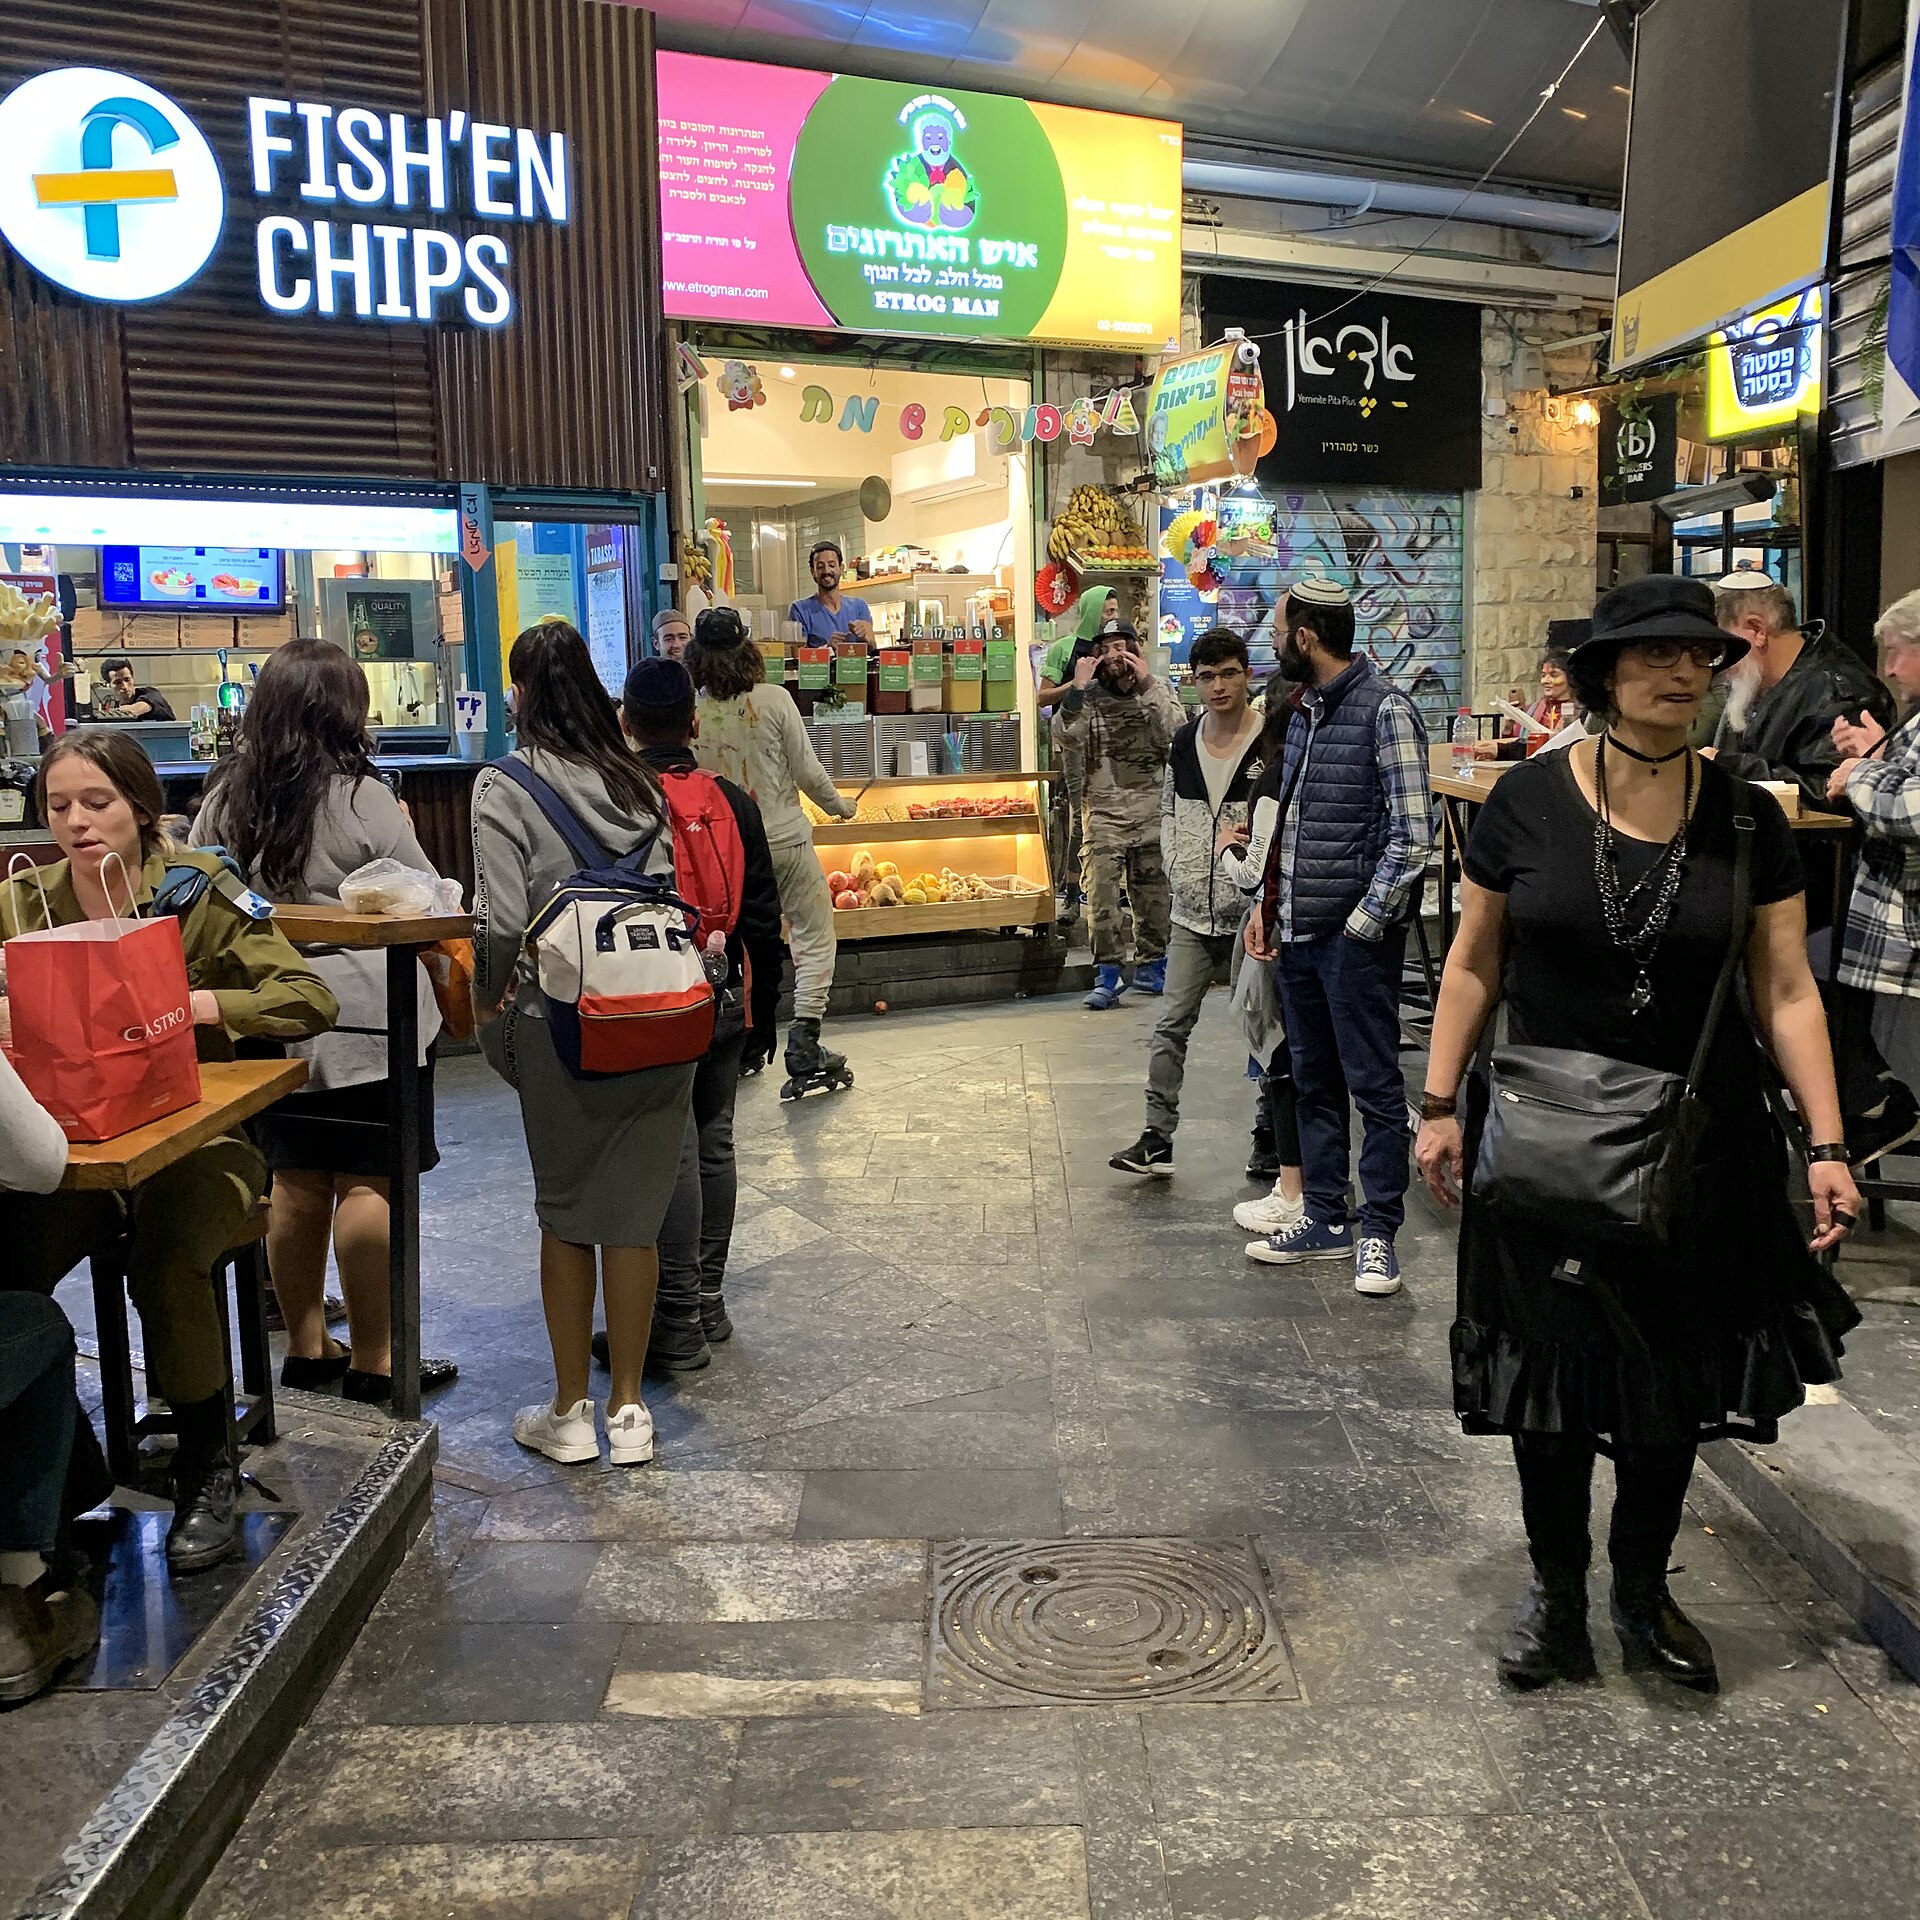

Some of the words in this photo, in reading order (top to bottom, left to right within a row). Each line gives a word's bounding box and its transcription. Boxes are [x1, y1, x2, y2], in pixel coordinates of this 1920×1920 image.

[680, 121, 715, 134] הטובים
[719, 126, 765, 139] הפתרונות
[666, 135, 697, 149] ללידה
[249, 97, 568, 222] FISH'EN
[676, 155, 700, 166] העור
[703, 158, 738, 170] לטיפוח
[668, 188, 706, 200] ולסכרת
[709, 192, 747, 205] לכאבים
[826, 223, 971, 263] האתרוגים
[978, 237, 1039, 268] איש
[256, 216, 512, 326] CHIPS
[863, 263, 899, 284] הגוף
[901, 262, 932, 284] לכל
[971, 267, 1004, 290] מכל
[874, 291, 947, 313] ETROG
[952, 297, 1000, 317] MAN
[1163, 352, 1224, 386] שותים
[1742, 347, 1795, 376] פסטה
[1743, 371, 1793, 397] בסטה
[1154, 379, 1217, 412] בריאות
[1321, 441, 1358, 453] למהדרין
[1361, 442, 1379, 453] כשר
[590, 543, 617, 566] TABASCO
[371, 602, 407, 611] QUALITY
[913, 625, 923, 637] 22
[933, 627, 943, 639] 17
[954, 627, 964, 639] 12
[974, 627, 982, 638] 6
[994, 627, 1002, 639] 3
[456, 693, 482, 717] Tip
[1253, 835, 1266, 873] NYC
[123, 1007, 186, 1042] CASTRO
